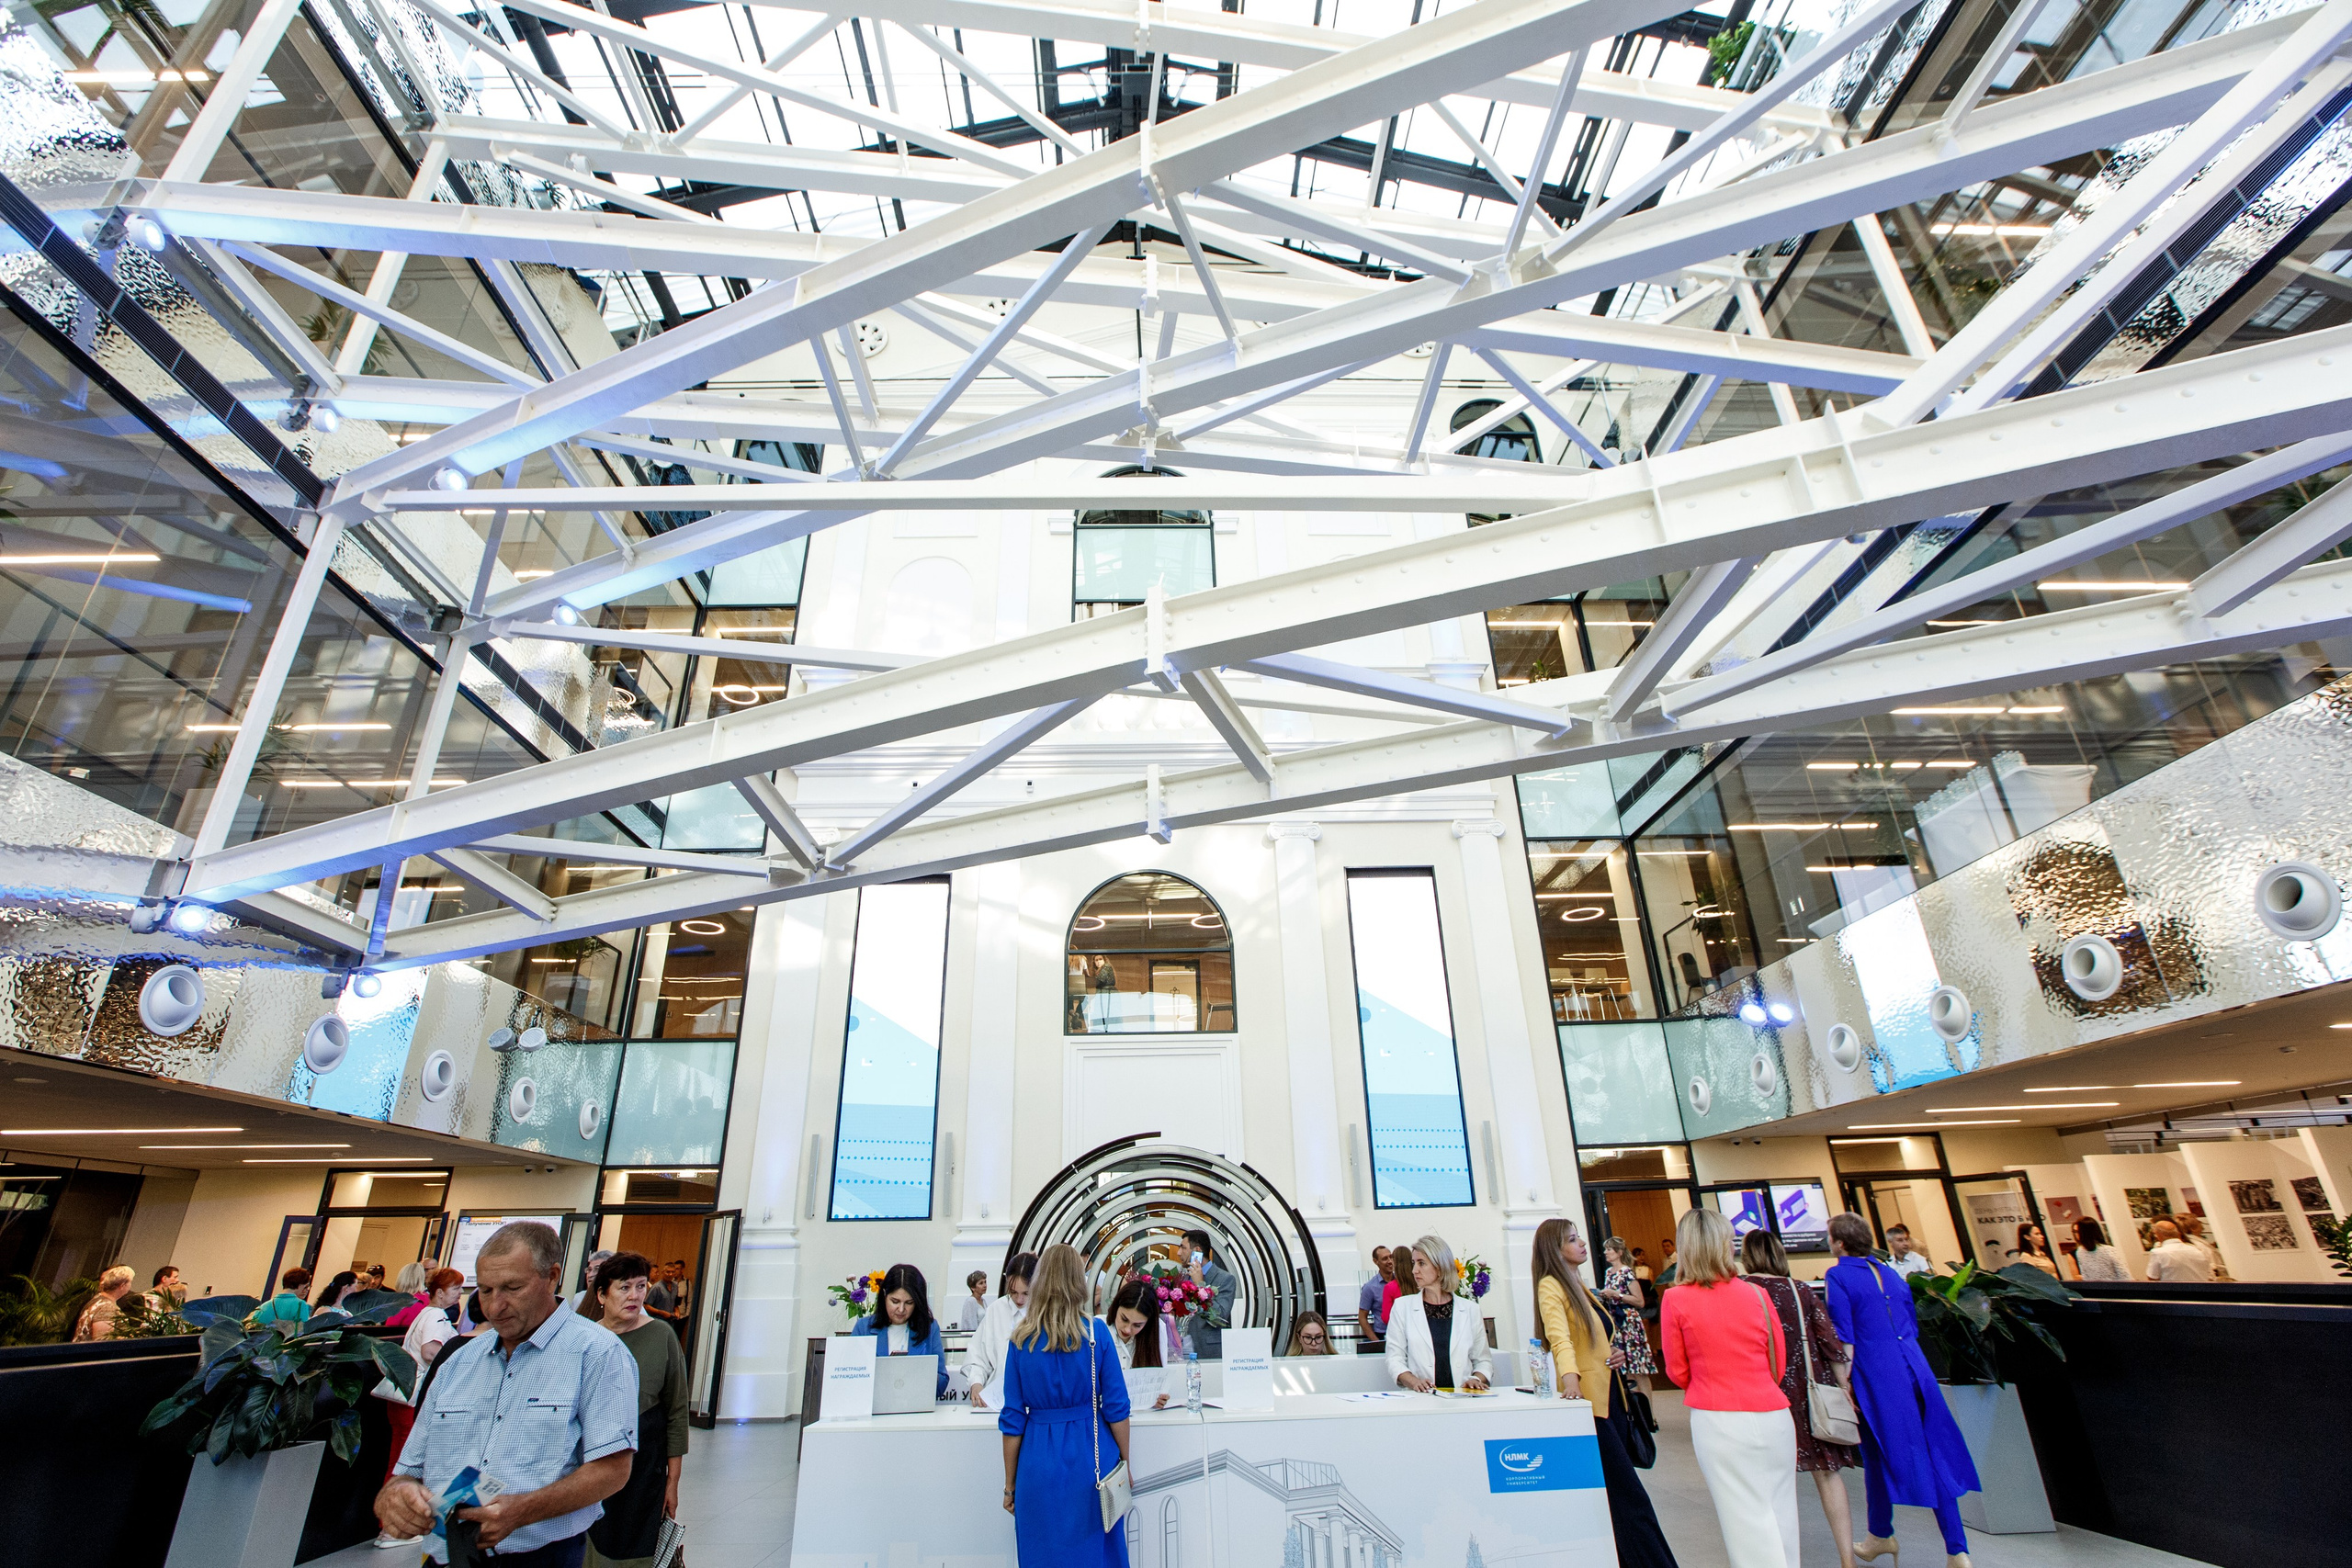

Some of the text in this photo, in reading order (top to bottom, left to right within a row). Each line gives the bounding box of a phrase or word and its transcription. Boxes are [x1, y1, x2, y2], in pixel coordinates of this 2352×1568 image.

[1998, 1215, 2017, 1224] ЭТО
[935, 1388, 957, 1401] ЫЙ
[1504, 1452, 1530, 1461] НЛМК
